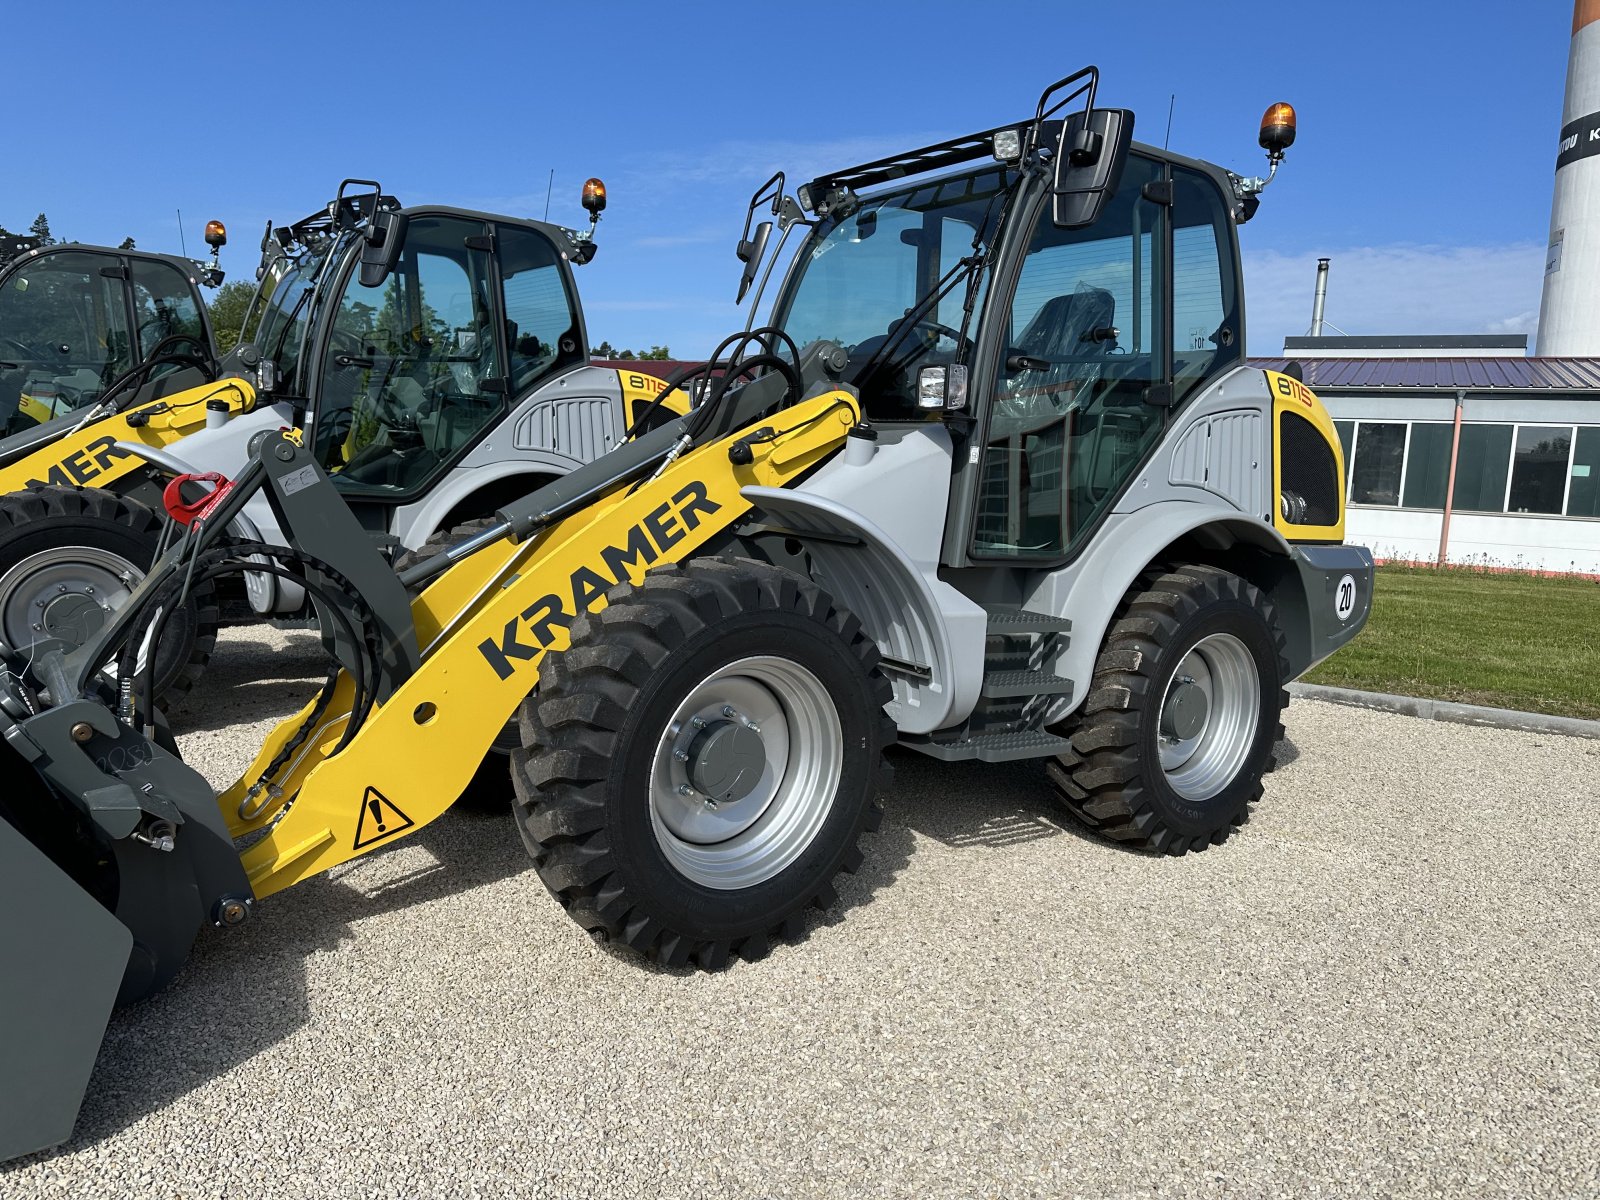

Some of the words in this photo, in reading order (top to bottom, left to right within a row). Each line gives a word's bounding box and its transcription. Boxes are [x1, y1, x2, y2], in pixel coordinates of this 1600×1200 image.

[1277, 376, 1313, 408] 8115
[477, 480, 722, 681] KRAMER
[1339, 582, 1352, 612] 20
